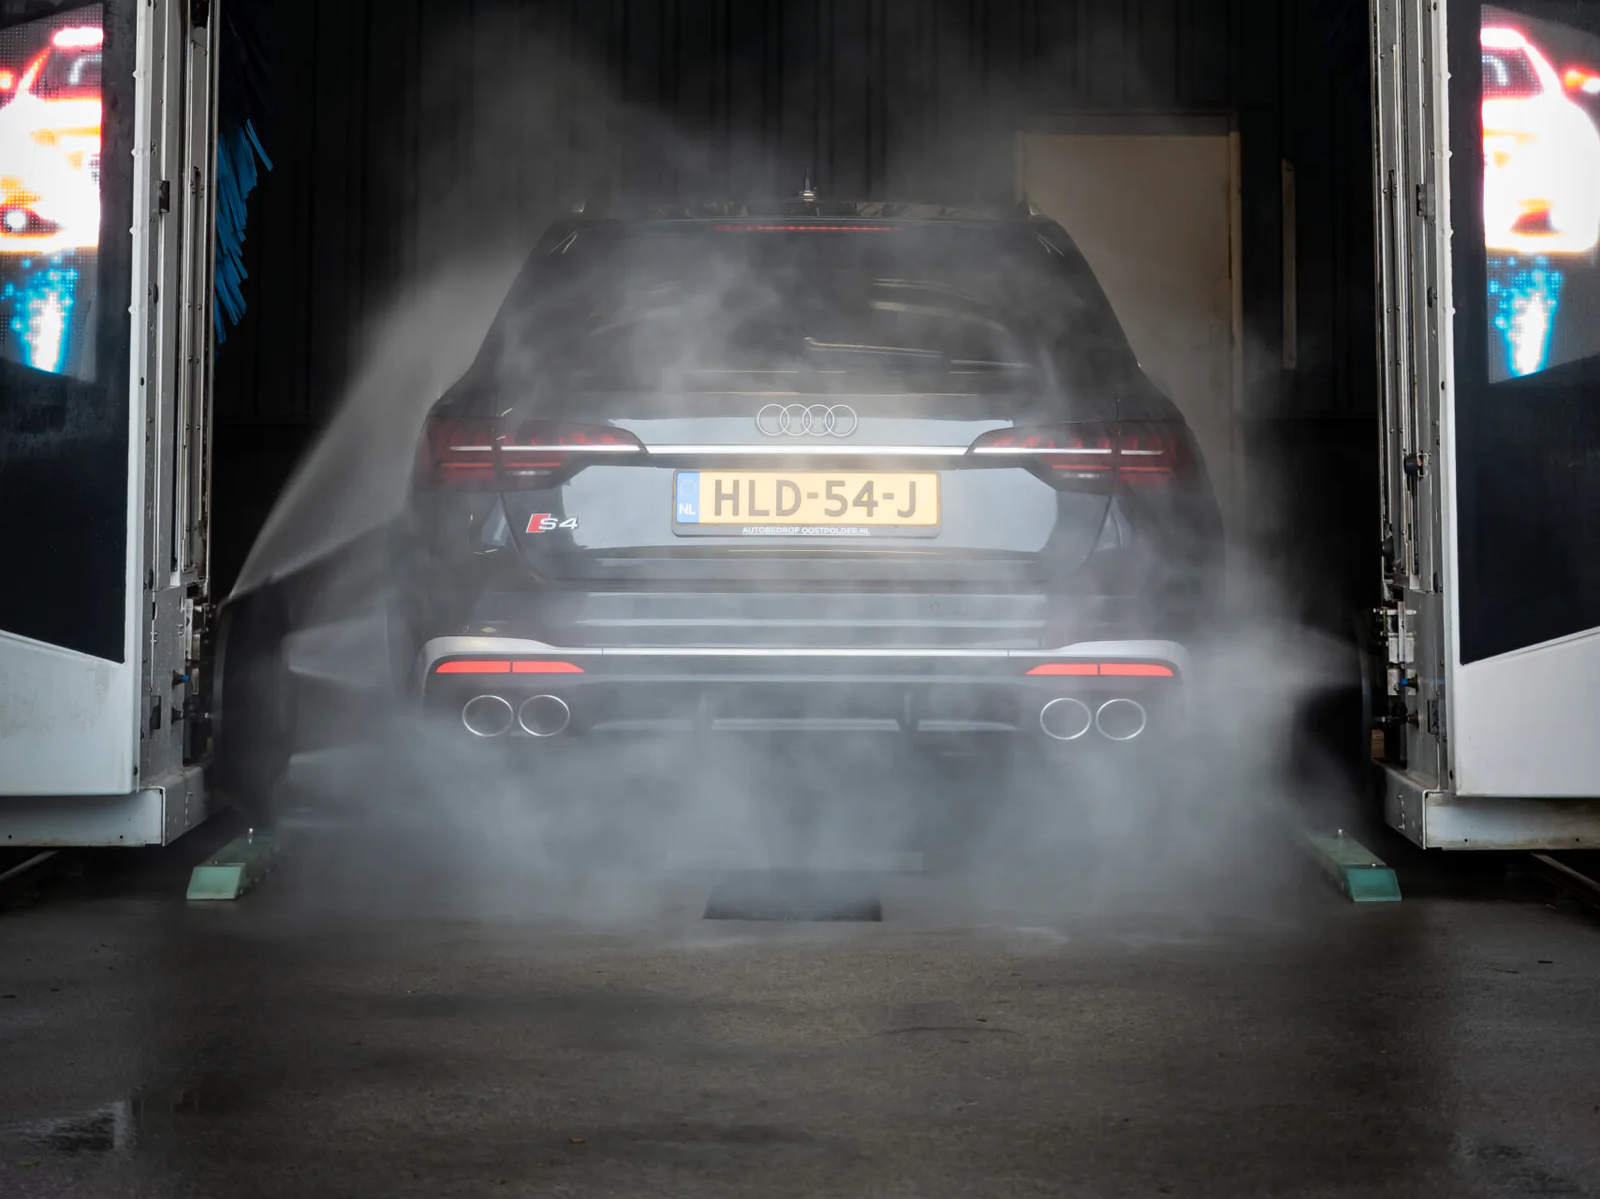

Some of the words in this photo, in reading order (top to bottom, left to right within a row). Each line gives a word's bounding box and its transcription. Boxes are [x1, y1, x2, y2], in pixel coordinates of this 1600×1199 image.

[679, 503, 696, 516] NL
[714, 479, 916, 518] HLD-54-J
[538, 517, 578, 530] S4
